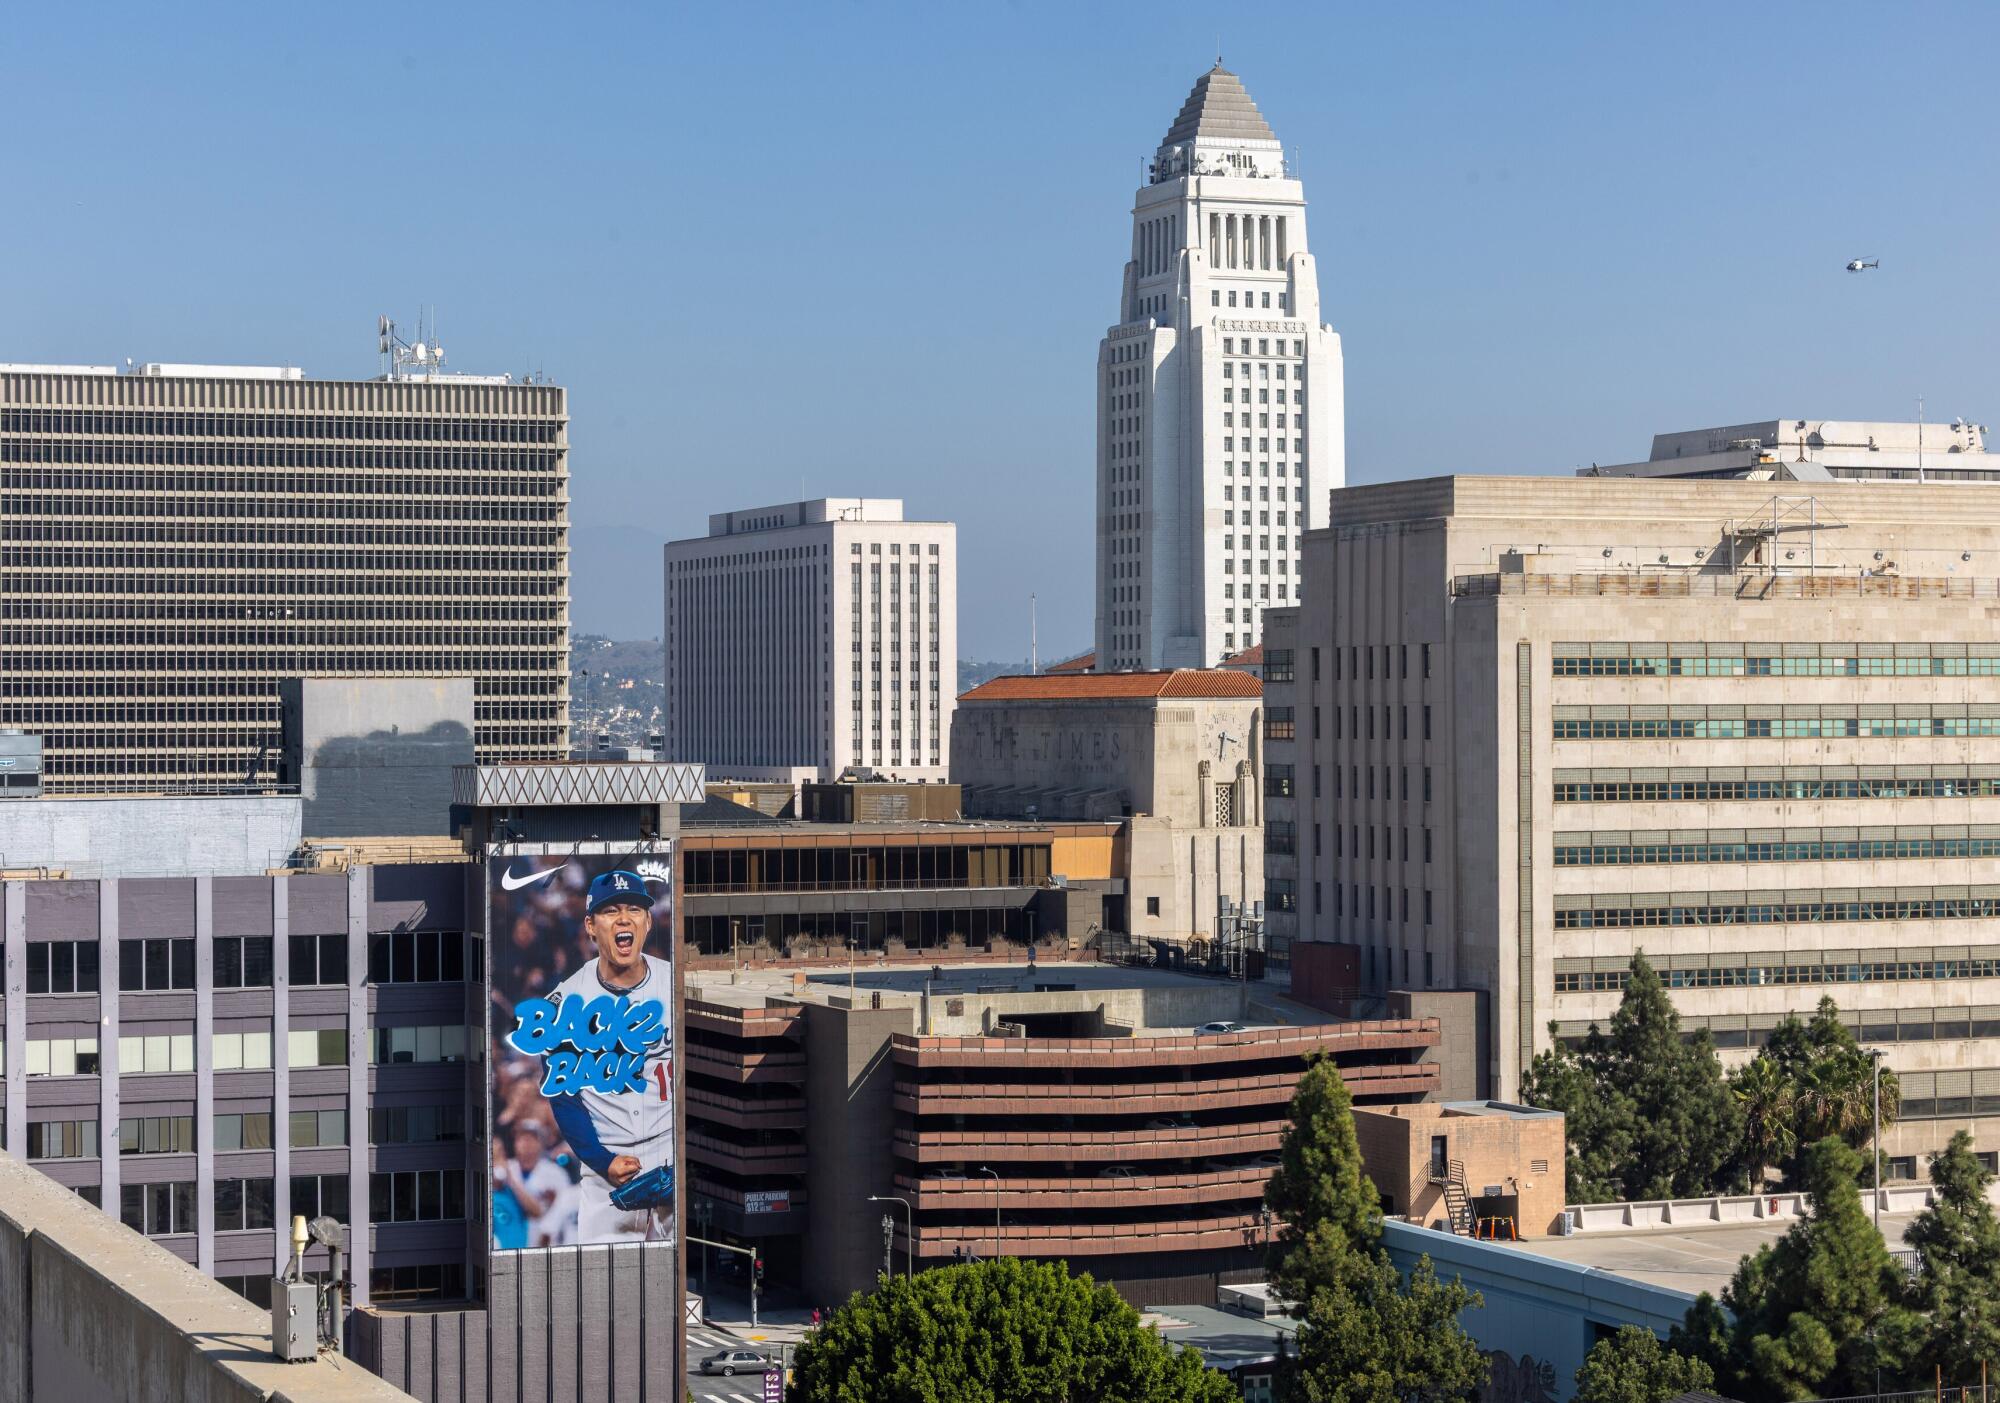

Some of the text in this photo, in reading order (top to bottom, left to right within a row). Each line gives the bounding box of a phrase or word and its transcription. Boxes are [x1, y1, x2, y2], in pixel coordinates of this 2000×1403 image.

[976, 731, 1120, 760] THE TIMES
[614, 874, 630, 890] LA
[541, 1051, 648, 1098] BACK
[746, 1191, 788, 1202] PUBLIC PARKING
